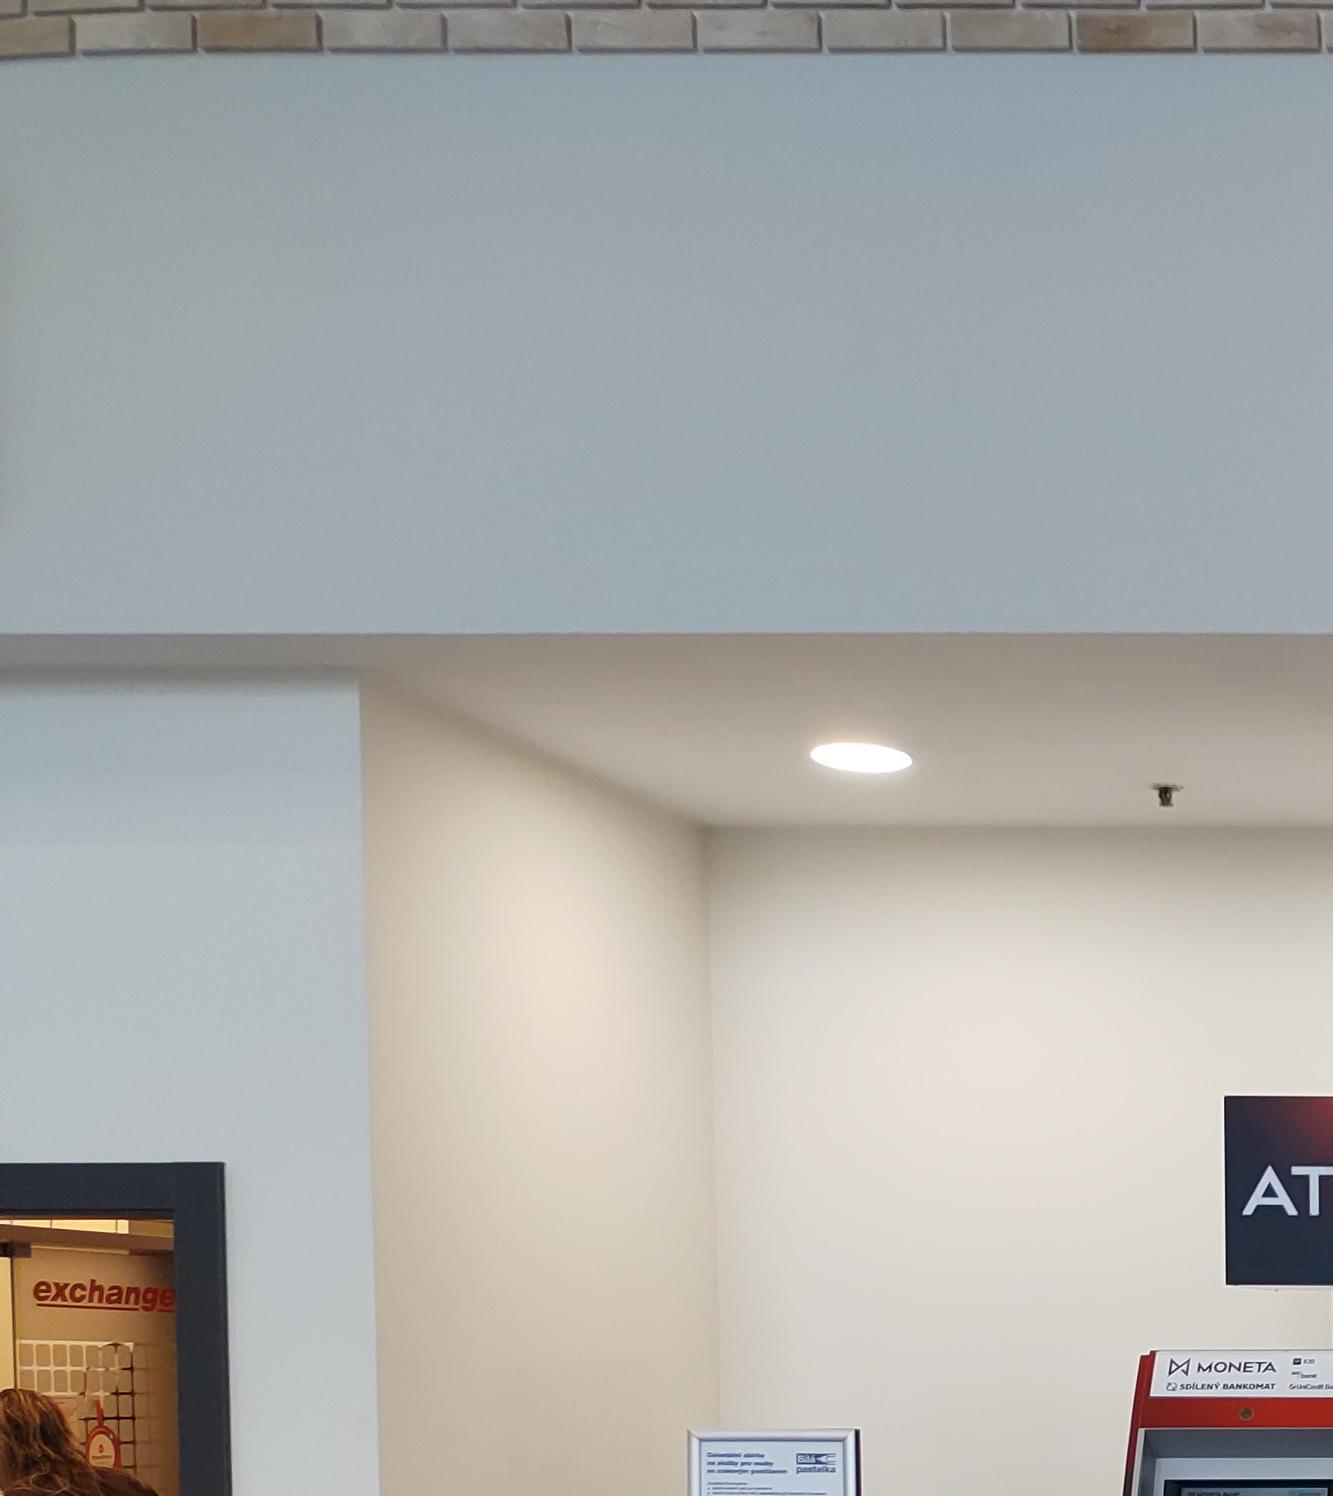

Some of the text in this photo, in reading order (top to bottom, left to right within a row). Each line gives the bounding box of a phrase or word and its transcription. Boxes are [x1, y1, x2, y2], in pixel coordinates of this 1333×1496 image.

[33, 1279, 175, 1312] exchange
[1197, 1361, 1277, 1373] MONETA
[1179, 1381, 1220, 1390] SDÍLENÝ
